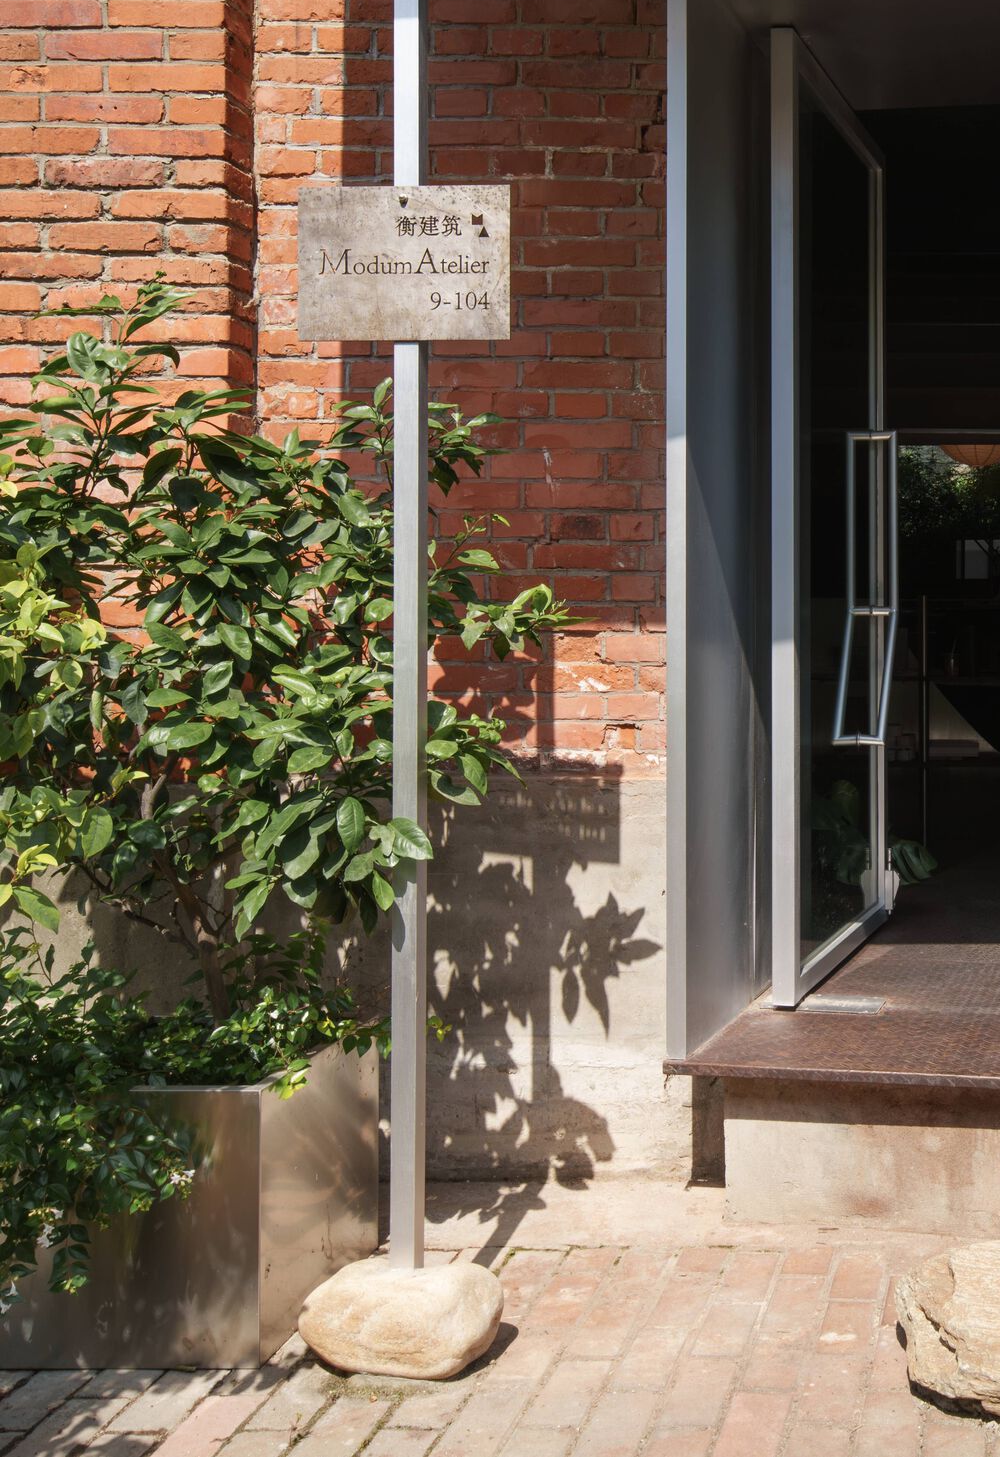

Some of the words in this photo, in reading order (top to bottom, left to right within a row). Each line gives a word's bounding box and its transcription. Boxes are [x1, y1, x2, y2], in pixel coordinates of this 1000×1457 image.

[396, 215, 462, 237] 衡建筑
[430, 291, 490, 310] 9-104
